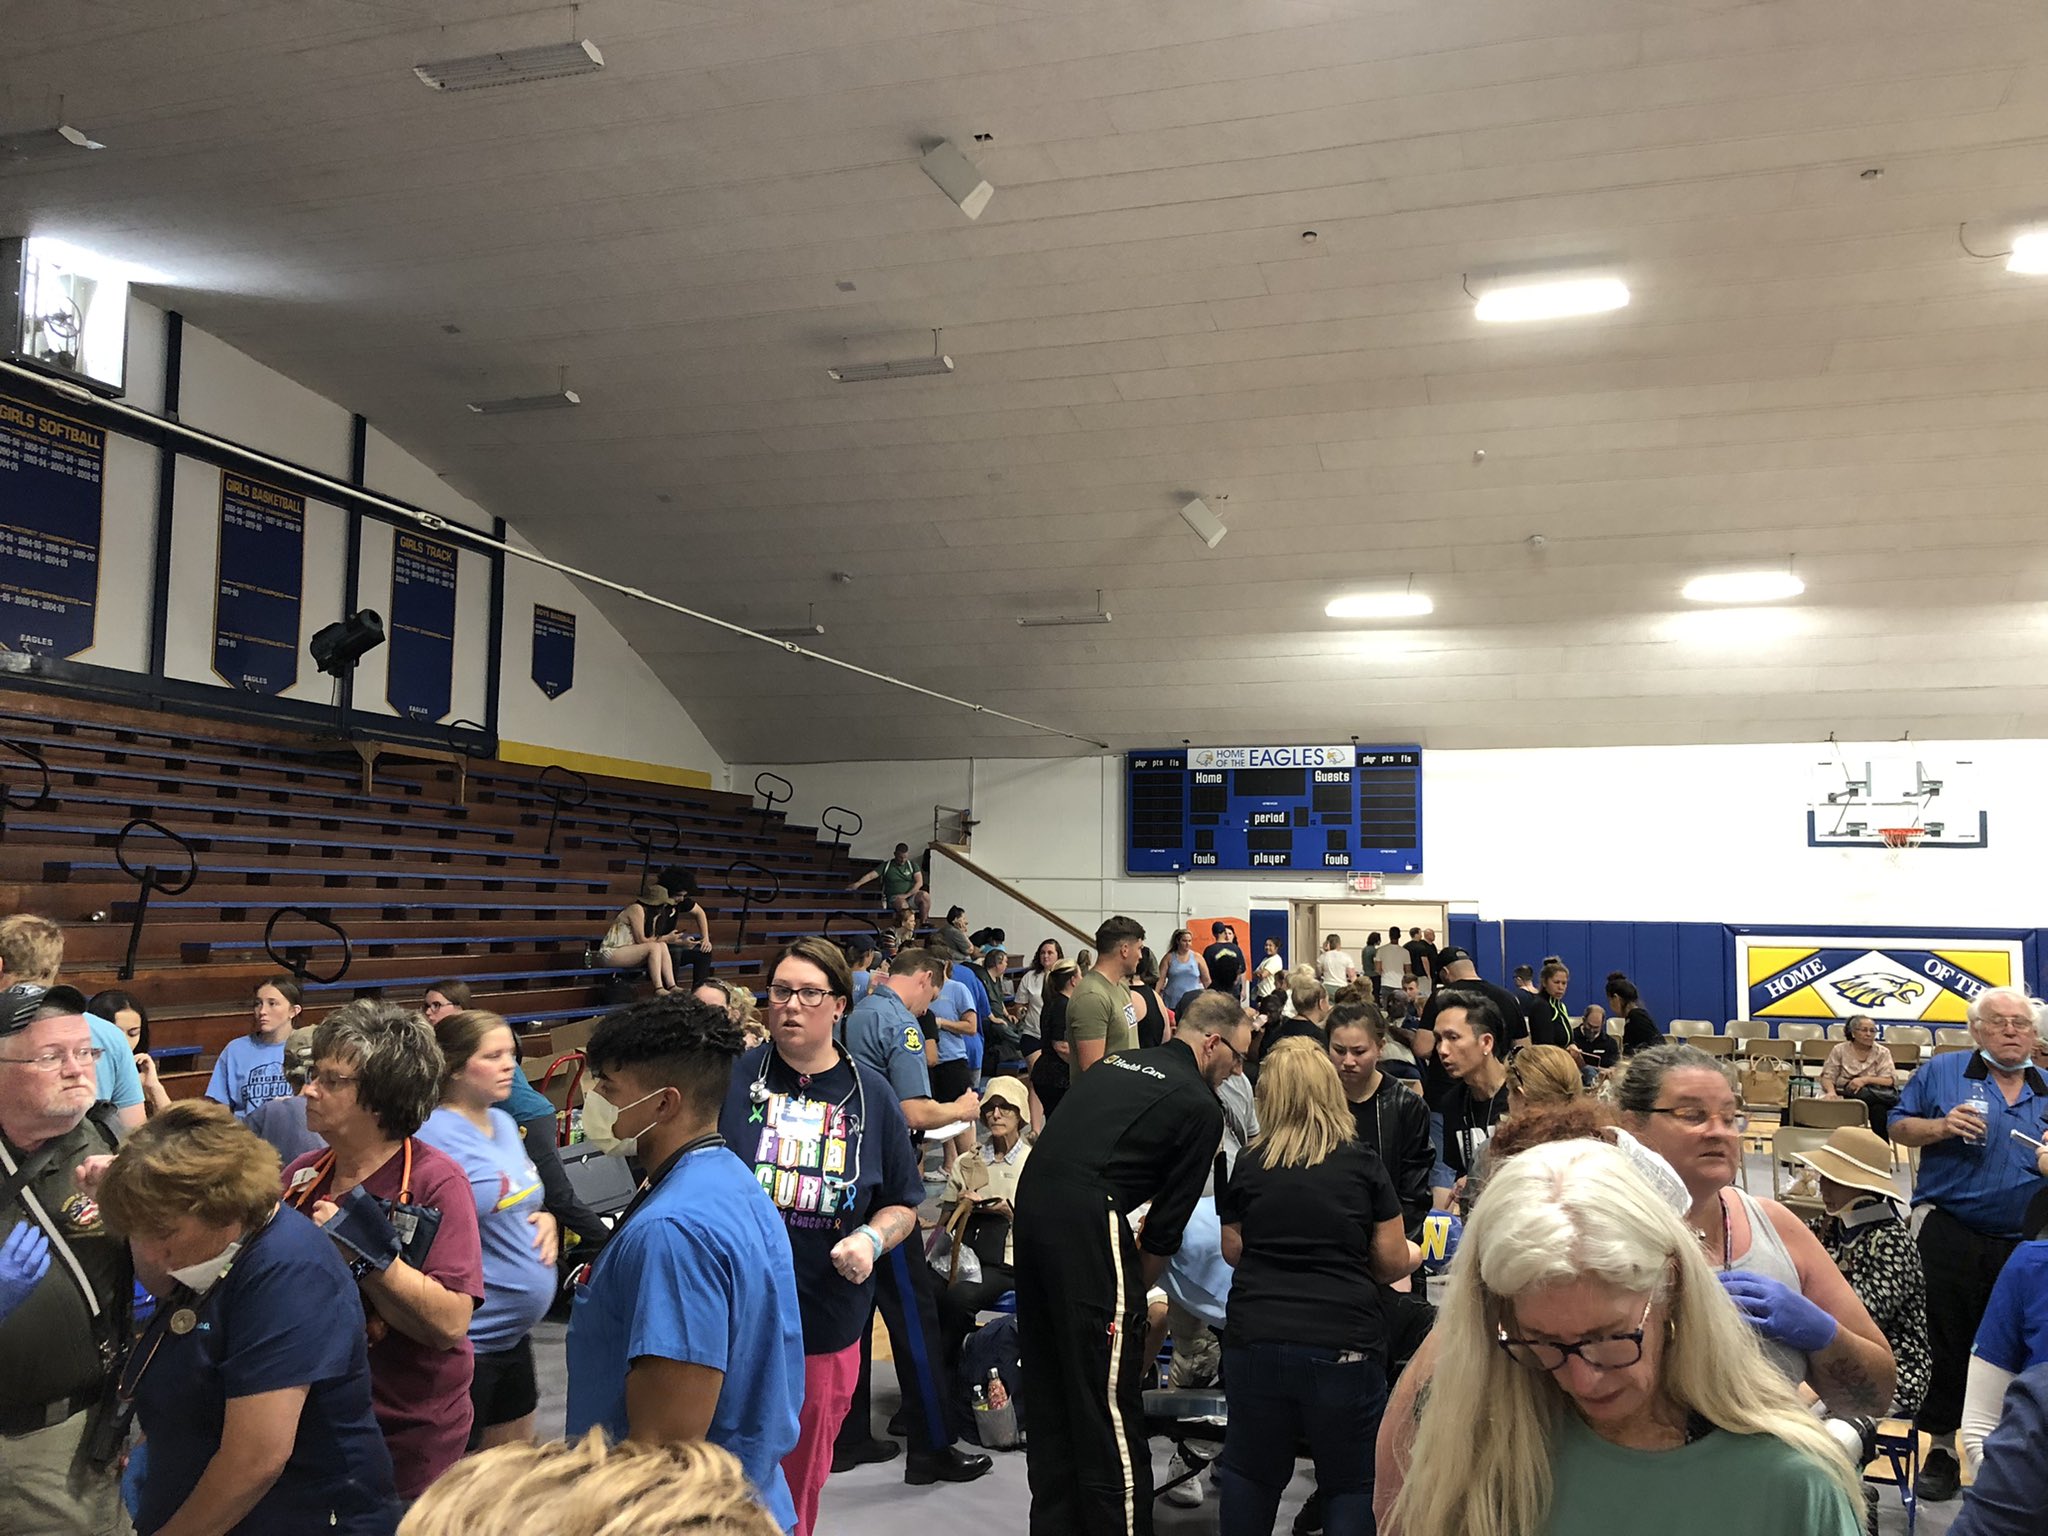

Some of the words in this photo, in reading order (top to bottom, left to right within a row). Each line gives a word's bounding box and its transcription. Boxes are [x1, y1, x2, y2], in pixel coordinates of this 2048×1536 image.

[0, 404, 35, 429] GIRLS
[39, 418, 101, 449] SOFTBALL
[226, 479, 250, 497] GIRLS
[251, 487, 302, 514] BASKETBALL
[400, 536, 424, 554] GIRLS
[425, 544, 453, 563] TRACK
[20, 633, 54, 647] EAGLES
[243, 674, 268, 685] EAGLES
[408, 705, 429, 715] EAGLES
[1216, 749, 1244, 758] HOME
[1249, 748, 1325, 767] EAGLES
[1381, 755, 1394, 764] pts
[1152, 759, 1164, 768] pts
[1215, 759, 1228, 768] OF
[1231, 759, 1245, 768] THE
[1195, 771, 1223, 784] Home
[1314, 770, 1350, 783] Guests
[1254, 811, 1285, 825] period
[1193, 853, 1216, 865] fouls
[1254, 852, 1286, 866] player
[1325, 853, 1349, 865] fouls
[1764, 957, 1827, 999] HOME
[1924, 958, 1956, 982] OF
[1953, 972, 1985, 998] TH
[1113, 1058, 1142, 1072] Health
[1142, 1066, 1166, 1080] Care
[756, 1128, 819, 1169] FOR
[756, 1166, 840, 1214] CURE
